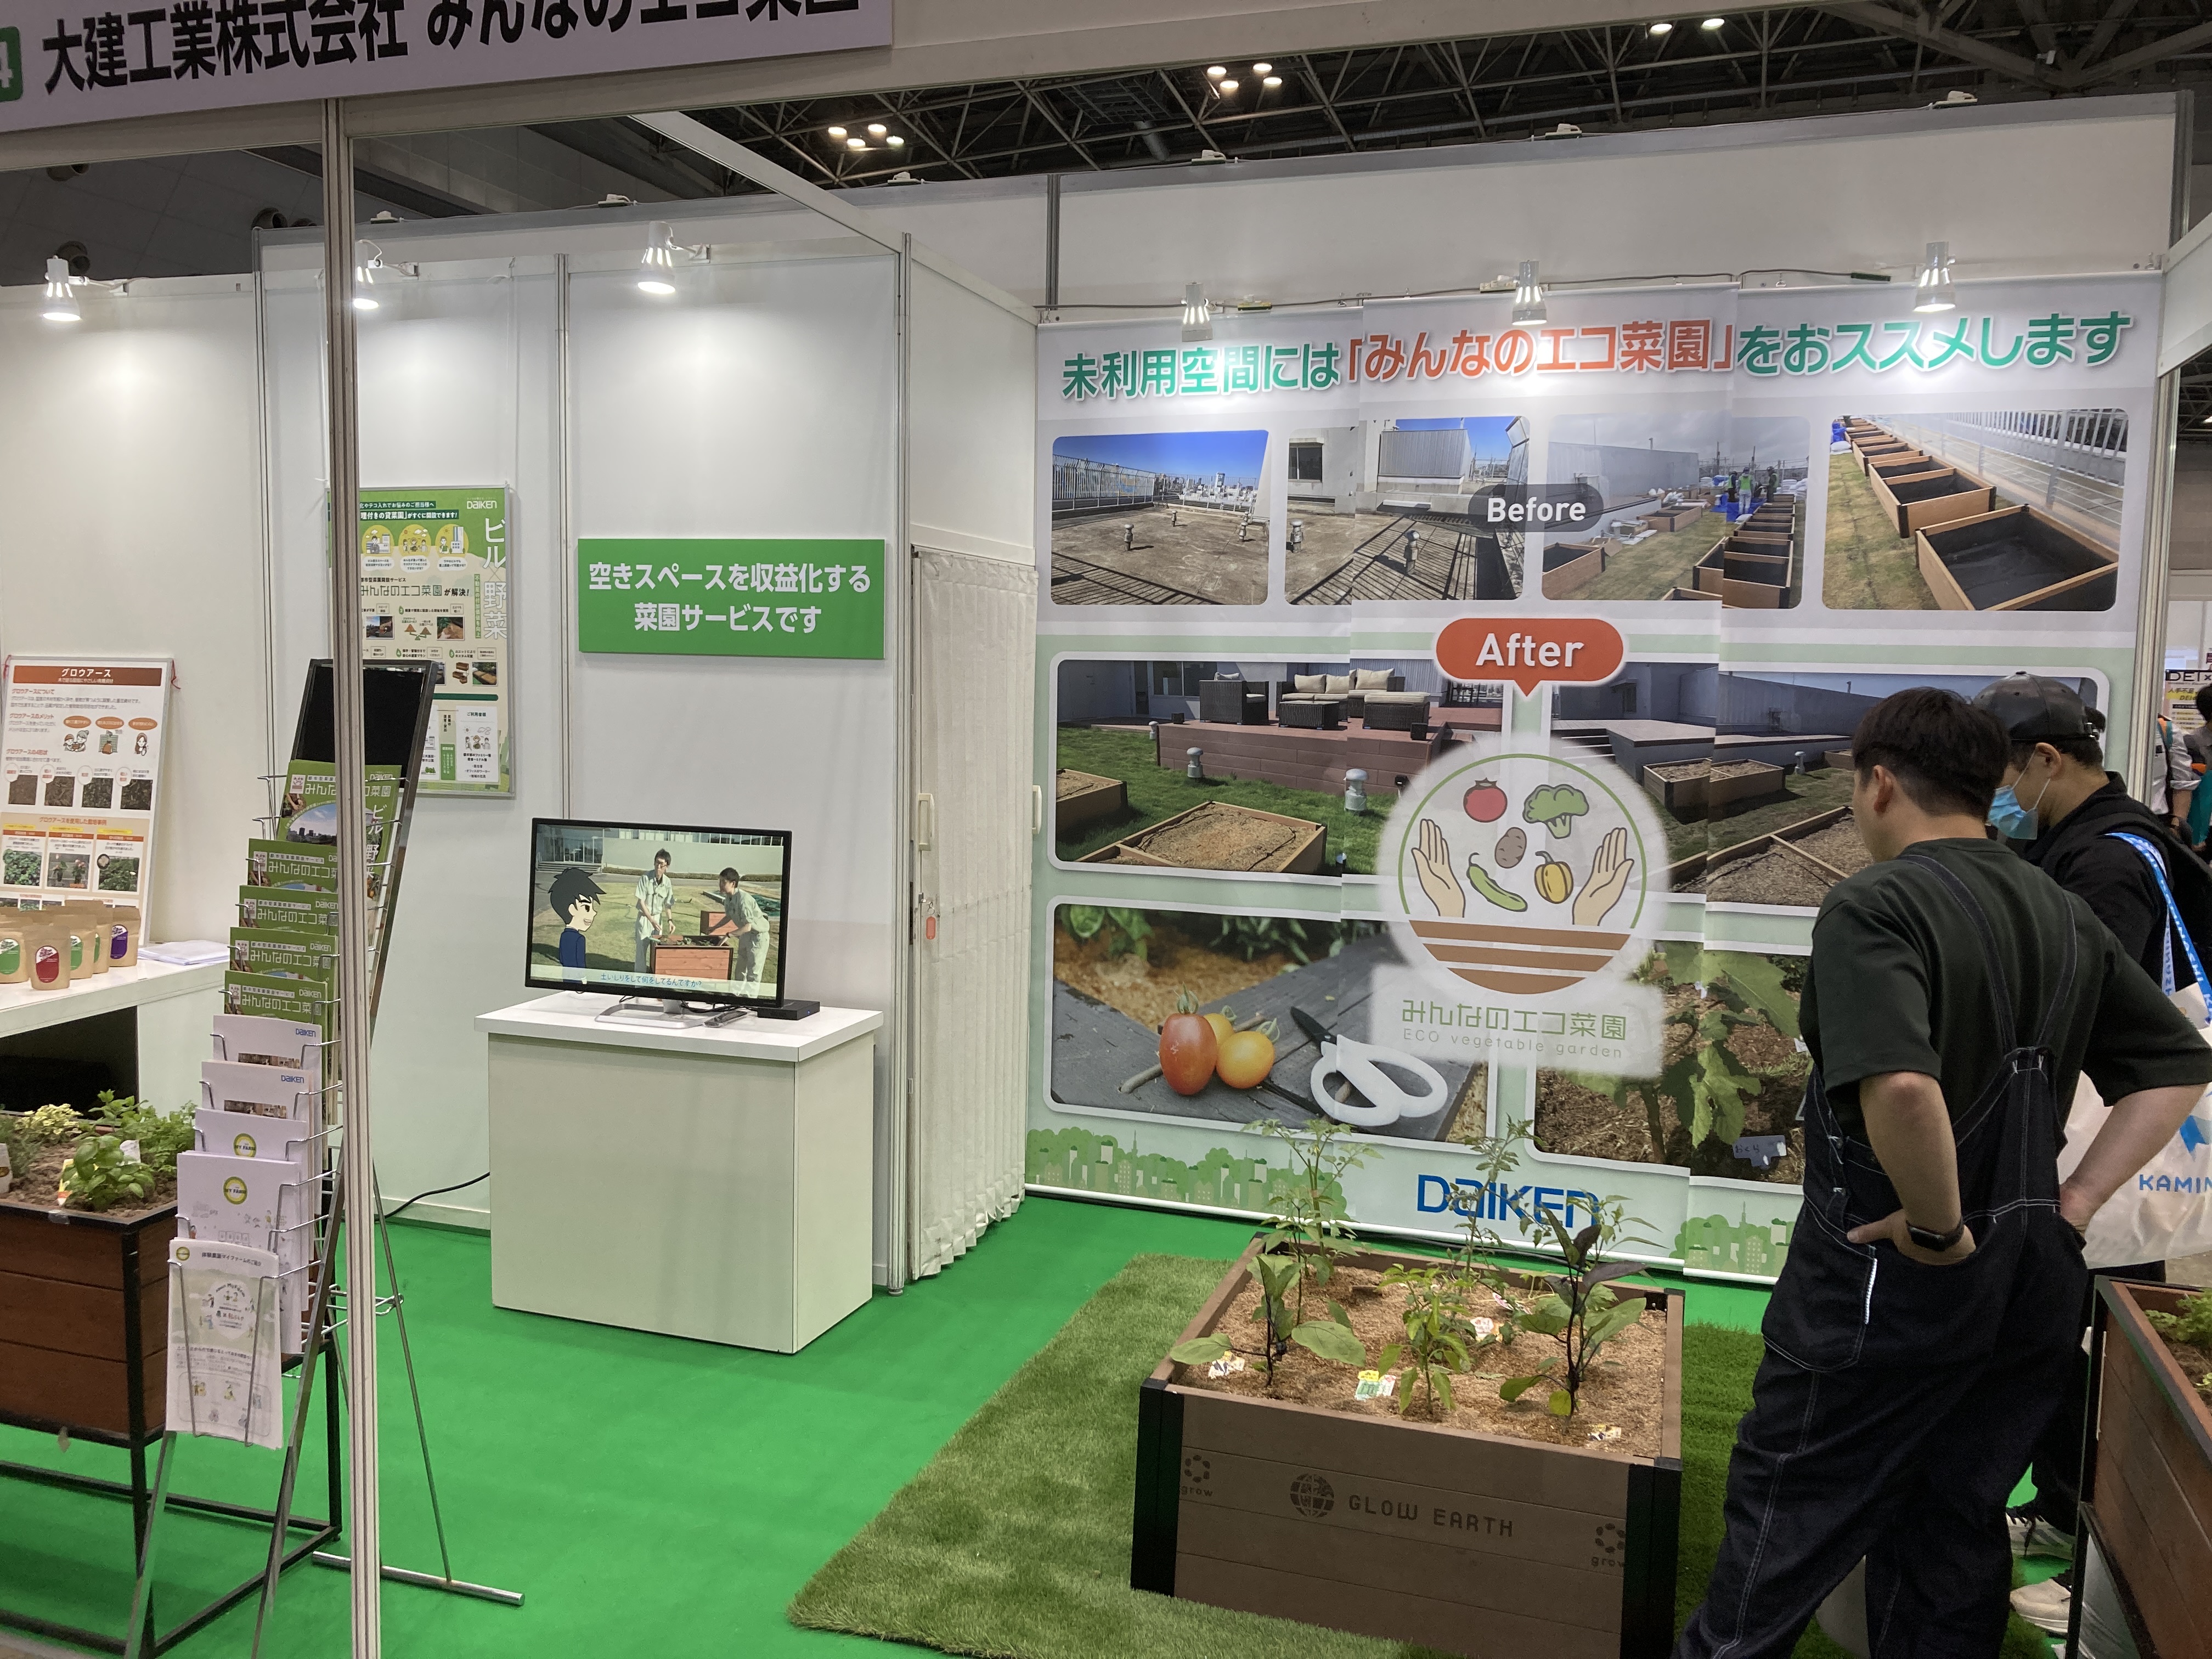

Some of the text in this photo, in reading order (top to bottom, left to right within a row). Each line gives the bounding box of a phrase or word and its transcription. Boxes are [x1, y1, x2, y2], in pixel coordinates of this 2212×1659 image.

[42, 0, 408, 95] 大建工業株式会社
[1487, 496, 1586, 522] Before
[589, 561, 871, 594] 空きスペースを収益化する
[634, 602, 822, 634] 菜園サービスです
[1476, 633, 1585, 668] After
[61, 668, 111, 678] グロウアース
[1402, 1000, 1626, 1041] みんなのエコ菜園
[1403, 1028, 1623, 1059] ECO vegetable garden
[1180, 1486, 1214, 1497] grow
[1348, 1494, 1513, 1537] GLOW EARTH
